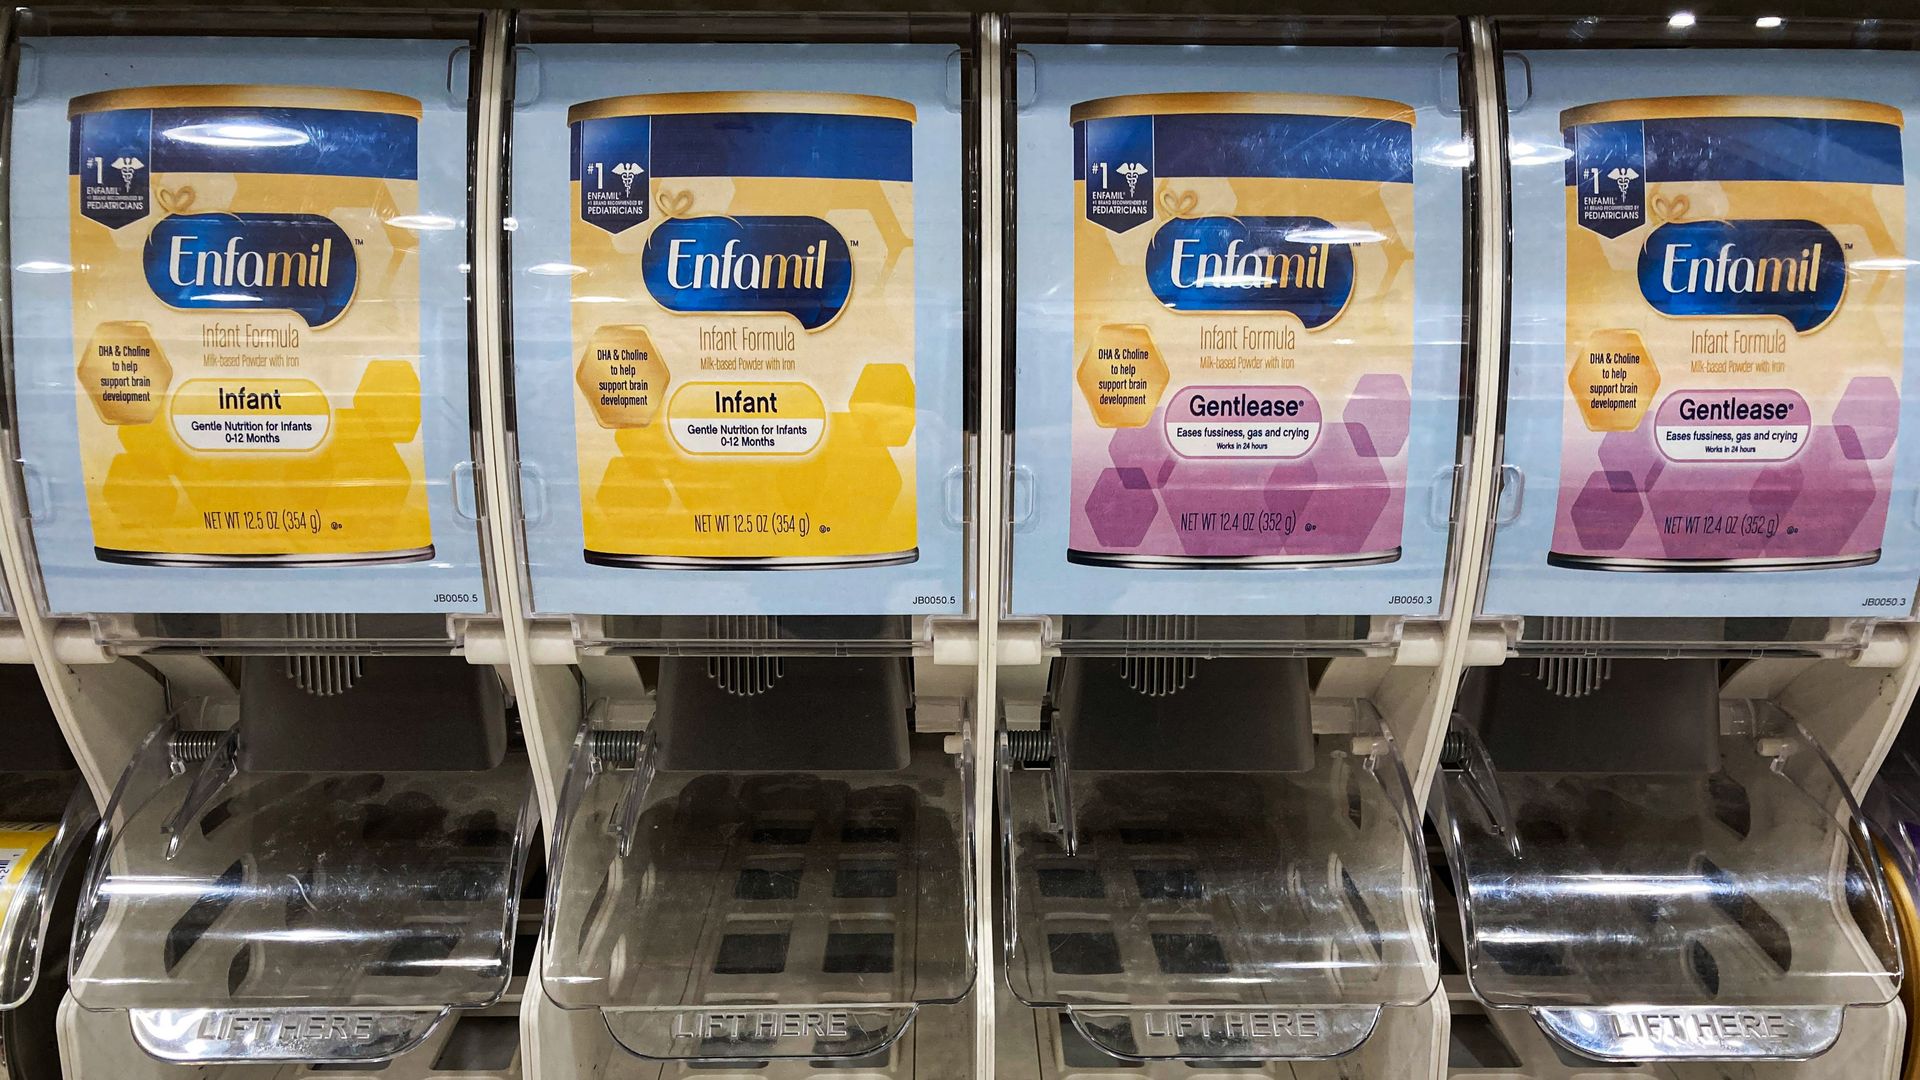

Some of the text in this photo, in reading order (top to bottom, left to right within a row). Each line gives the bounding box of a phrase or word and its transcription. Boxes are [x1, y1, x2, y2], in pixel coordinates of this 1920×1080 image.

[87, 202, 143, 210] PEDIATRICIANS
[1093, 206, 1147, 214] PEDIATRICIANS
[169, 235, 331, 287] Enfamil
[667, 239, 827, 289] Enfamil
[1171, 239, 1329, 289] Enfamil
[1662, 243, 1822, 294] Enfamil
[202, 323, 299, 348] Infant Formula
[699, 325, 795, 351] Infant Formula
[1200, 325, 1295, 350] Infant Formula
[1691, 328, 1786, 354] Infant Formula
[98, 346, 150, 356] DHA & Choline
[598, 350, 648, 360] DHA & Choline
[1099, 349, 1148, 359] DHA & Choline
[203, 354, 299, 366] Milk-based Powder with Iron
[701, 357, 795, 370] Milk-based Powder with Iron
[1200, 356, 1294, 369] Milk-based Powder with Iron
[1590, 353, 1640, 364] DHA & Choline
[112, 361, 138, 374] to help
[611, 364, 636, 377] to help
[1111, 364, 1136, 377] to help
[1691, 361, 1785, 373] Milk-based Powder with Iron
[1603, 368, 1626, 381] to help
[101, 376, 150, 388] support brain
[599, 380, 648, 393] support brain
[1099, 379, 1147, 392] support brain
[1590, 383, 1638, 396] support brain
[103, 390, 151, 404] development
[218, 387, 282, 410] Infant
[601, 395, 647, 408] development
[716, 390, 778, 413] Infant
[1100, 394, 1146, 407] development
[1591, 398, 1636, 411] development
[191, 421, 312, 431] Gentle Nutrition for Infants
[688, 424, 807, 435] Gentle Nutrition for Infants
[225, 433, 280, 443] 0-12 Months
[1177, 427, 1309, 440] Eases fussiness, gas and crying
[1666, 431, 1798, 442] Eases fussiness, gas and crying
[721, 437, 775, 447] 0-12 Months
[204, 509, 321, 533] NET WT 12.5 OZ (354 g)
[695, 512, 810, 537] NET WT 12.5 OZ (354 g)
[1181, 510, 1297, 535] NET WT 12.4 OZ (352 g)
[1664, 514, 1779, 538] NET WT 12.4 OZ (352 g)
[434, 594, 478, 602] JB0050.5
[913, 596, 955, 604] JB0050.5
[1389, 596, 1432, 604] JB0050.3
[1862, 598, 1906, 606] JB0050.3
[197, 1016, 373, 1040] LIFT HERE
[676, 1012, 848, 1038] LIFT HERE
[1145, 1013, 1319, 1037] LIFT HERE
[1611, 1013, 1788, 1038] LIFT HERE
